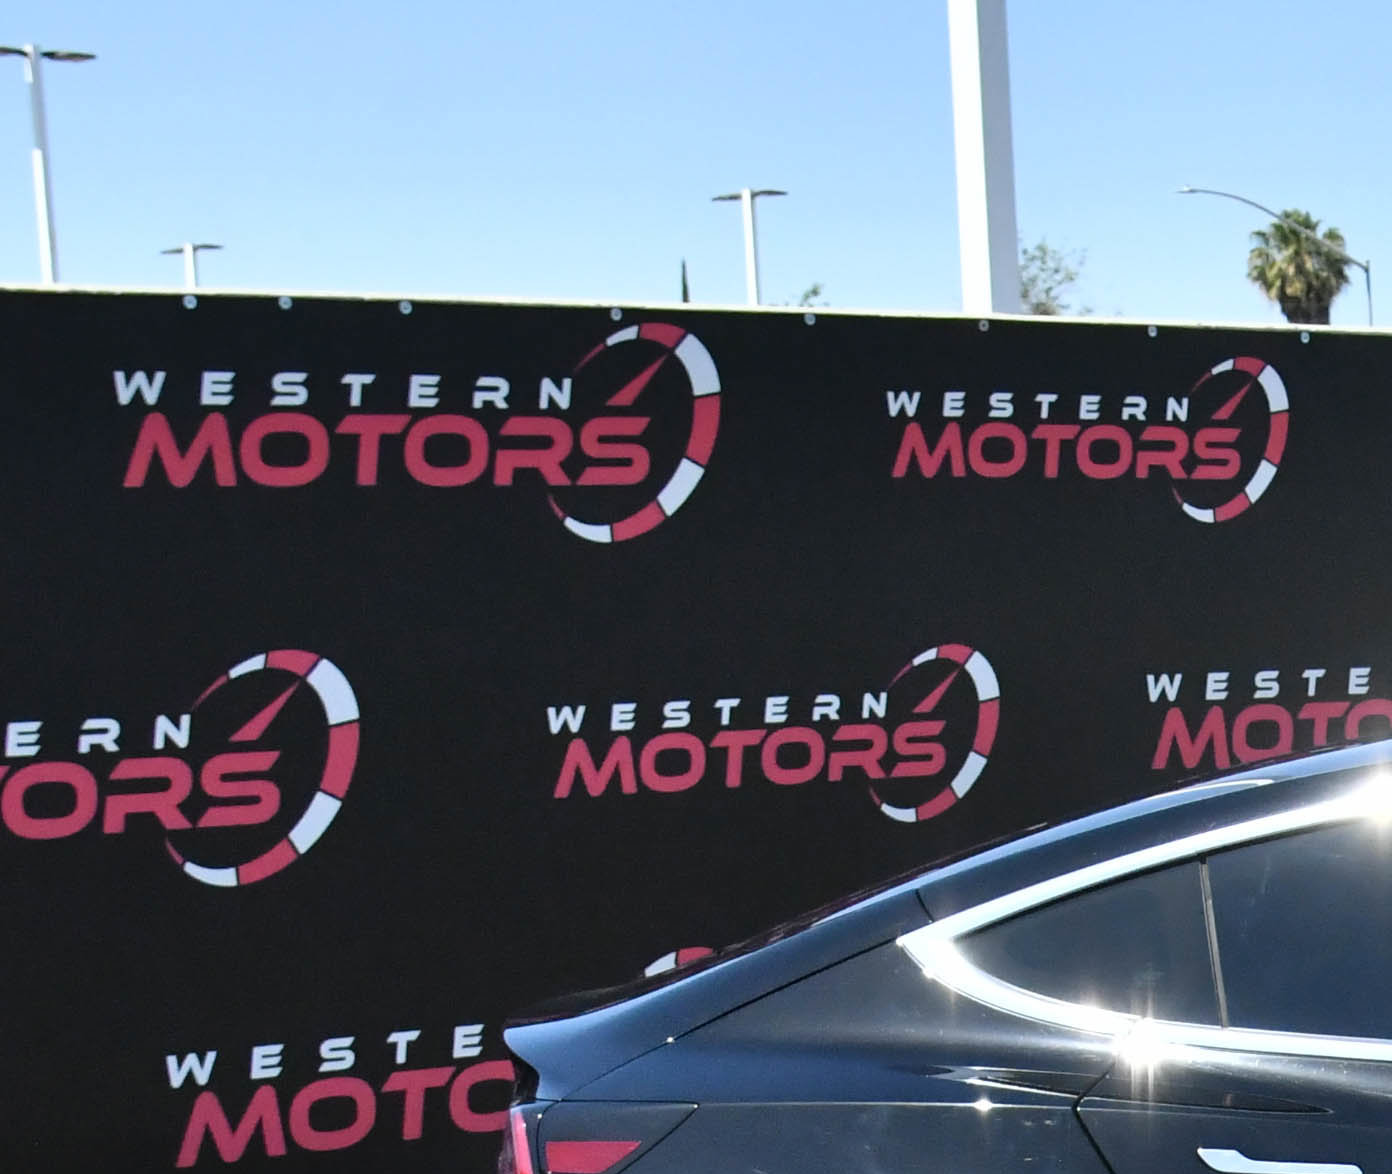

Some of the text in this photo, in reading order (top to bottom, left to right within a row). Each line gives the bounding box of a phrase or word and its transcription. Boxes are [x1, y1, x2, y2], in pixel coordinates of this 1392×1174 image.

[114, 371, 572, 410] WESTERN
[887, 391, 1189, 422] WESTERN
[123, 412, 650, 487] MOTORS
[892, 422, 1241, 480] MOTORS
[5, 714, 191, 757] ERN
[547, 691, 888, 735] WESTERN
[554, 720, 946, 798] MOTORS
[0, 751, 281, 839] ORS
[166, 1023, 484, 1089] WESTE
